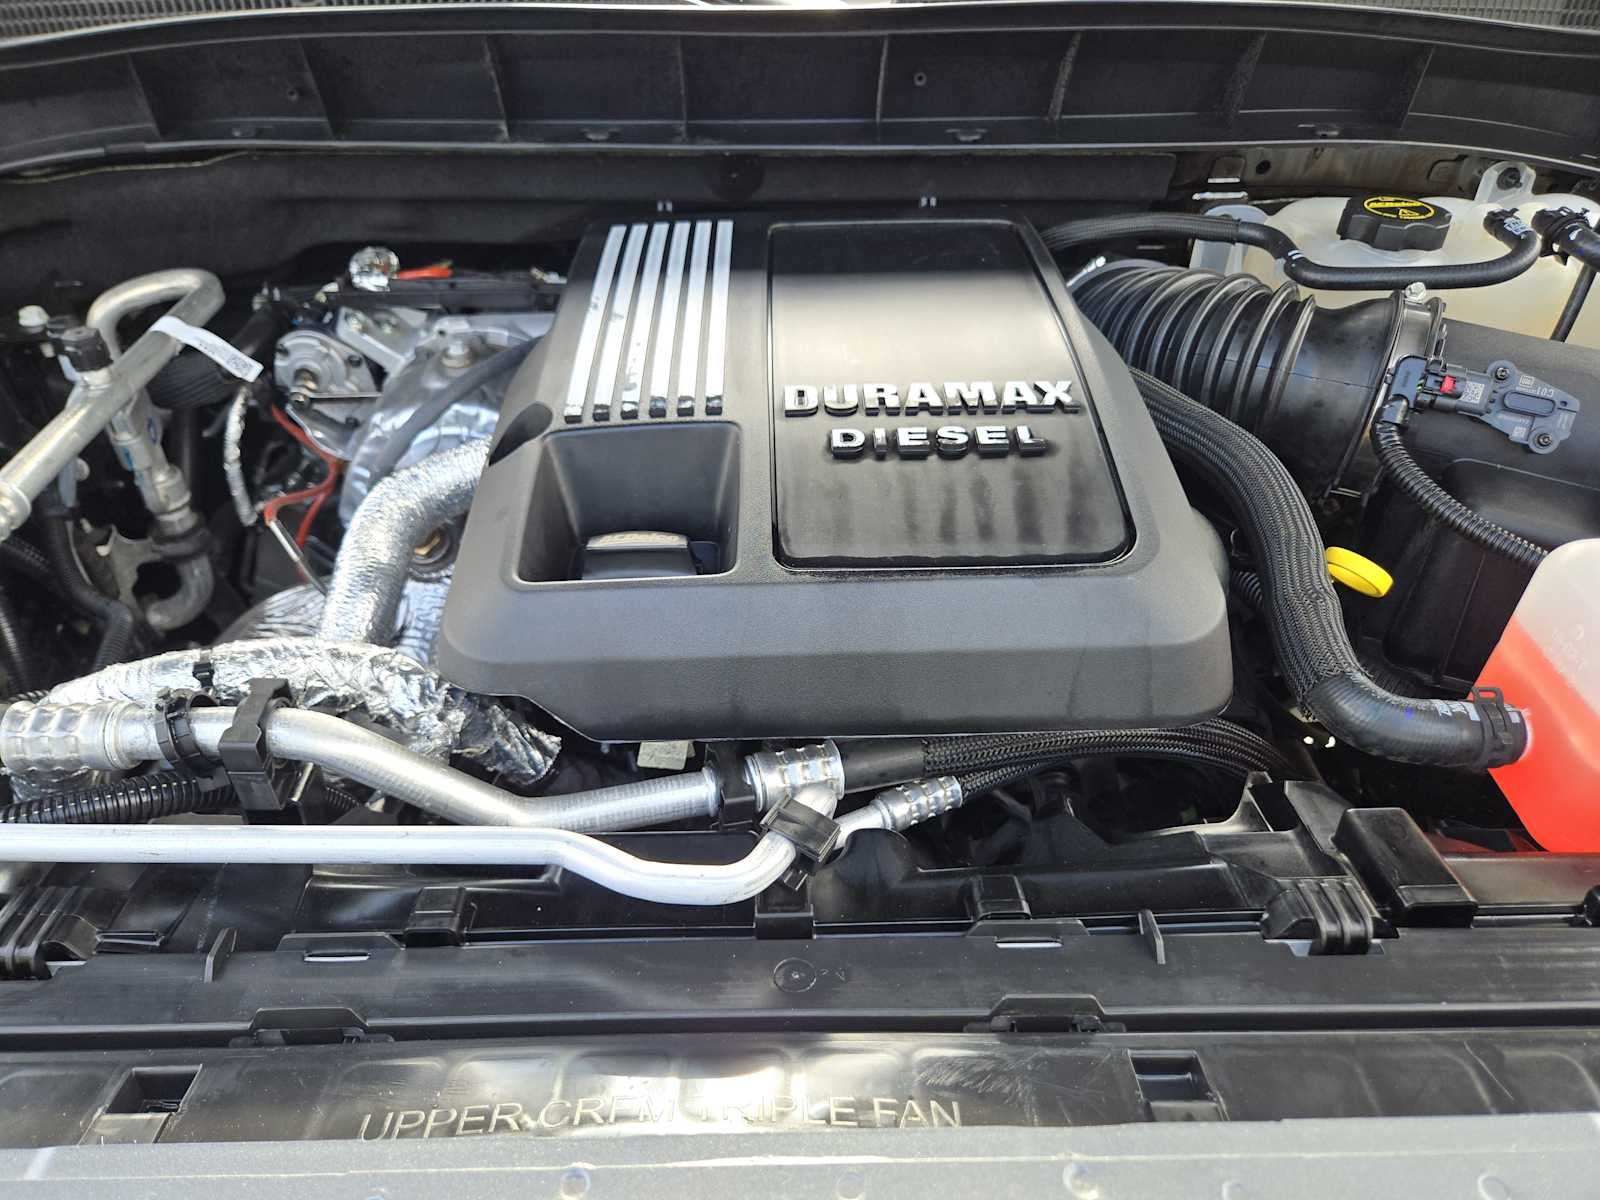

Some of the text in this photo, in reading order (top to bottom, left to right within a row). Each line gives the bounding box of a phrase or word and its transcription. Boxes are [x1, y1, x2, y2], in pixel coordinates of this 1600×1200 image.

[783, 380, 1081, 417] DURAMAX
[829, 424, 1046, 459] DIESEL
[358, 1102, 523, 1142] UPPER
[873, 1097, 962, 1128] FAN
